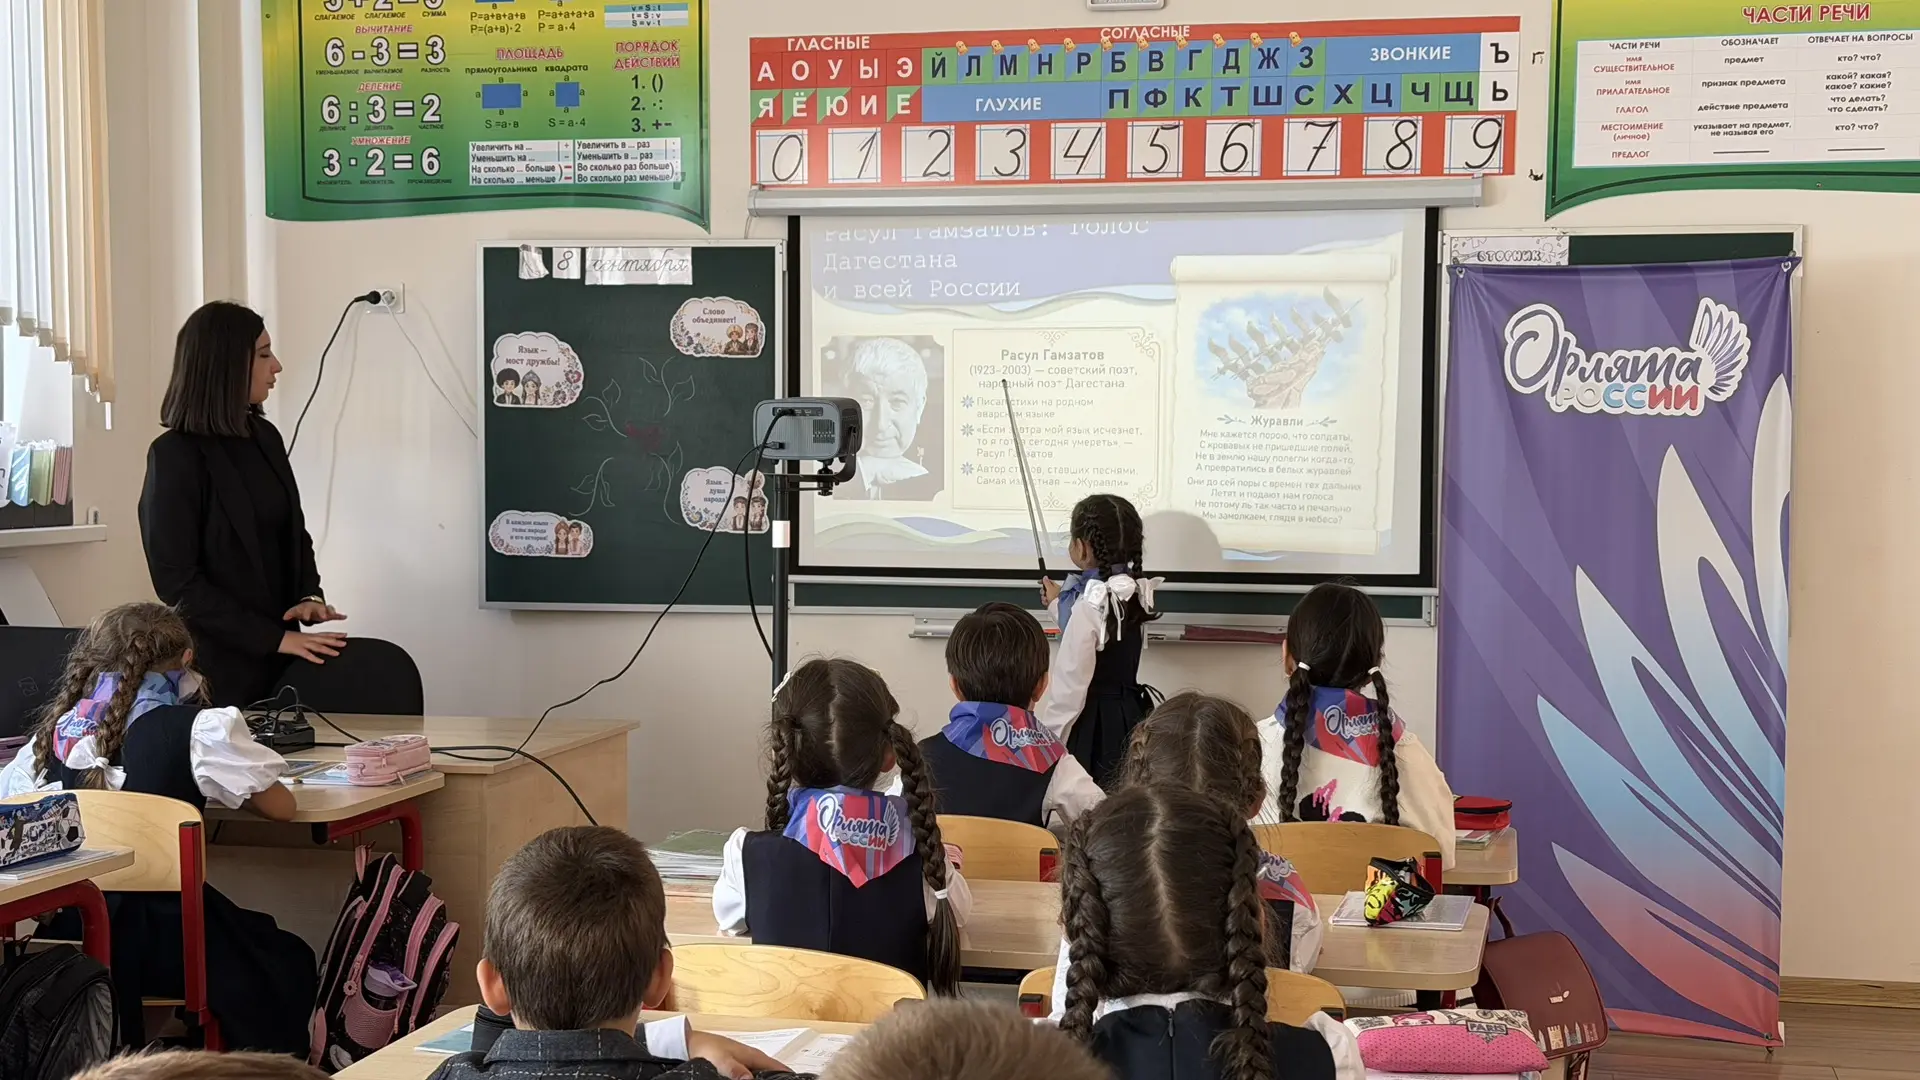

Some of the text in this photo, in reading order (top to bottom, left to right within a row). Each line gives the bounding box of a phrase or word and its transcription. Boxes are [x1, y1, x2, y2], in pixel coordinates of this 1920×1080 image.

[364, 12, 407, 20] СЛАГАЕМОЕ
[1743, 3, 1872, 25] ЧАСТИ РЕЧИ
[355, 25, 413, 34] ВЫЧИТАНИЕ
[1100, 25, 1190, 40] СОГЛАСНЫЕ
[1721, 37, 1779, 47] ОБОЗНАЧАЕТ
[1807, 33, 1913, 44] ОТВЕЧАЕТ НА ВОПРОСЫ
[615, 40, 679, 52] ПОРЯДОК
[787, 37, 871, 52] ГЛАСНЫЕ
[1609, 41, 1661, 50] ЧАСТИ РЕЧИ
[325, 34, 447, 68] 6 3 3
[496, 48, 565, 60] ПЛОЩАДЬ
[1369, 46, 1452, 62] ЗВОНКИЕ
[1489, 42, 1510, 64] Ъ
[614, 56, 680, 70] ДЕЙСТВИЙ
[1724, 56, 1764, 65] предмет
[1837, 53, 1882, 63] кто? что?
[545, 64, 589, 74] квадрата
[757, 46, 1315, 82] А О У Ы Э Й Л М Н Р Б В Г Д Ж З
[1593, 64, 1675, 73] СУЩЕСТВИТЕЛЬНОЕ
[465, 65, 538, 75] прямоугольника
[1826, 71, 1892, 81] какой? какая?
[359, 82, 402, 91] ДЕЛЕНИЕ
[1702, 78, 1786, 88] признак предмета
[1825, 81, 1892, 91] какое? какие?
[1109, 81, 1474, 109] П Ф К Т Ш С Х Ц Ч Щ
[1491, 80, 1509, 102] Ь
[1596, 87, 1671, 96] ПРИЛАГАТЕЛЬНОЕ
[758, 91, 912, 118] Я Ё Ю И Е
[975, 97, 1042, 112] ГЛУХИЕ
[1830, 94, 1887, 104] что делать?
[321, 92, 442, 125] 6 3 2
[1616, 106, 1649, 114] ГЛАГОЛ
[1697, 102, 1789, 112] действие предмета
[1827, 104, 1889, 114] что сделать?
[1600, 122, 1664, 131] МЕСТОИМЕНИЕ
[1693, 123, 1737, 132] указывает
[1752, 121, 1792, 130] предмет,
[1835, 122, 1880, 132] кто? что?
[351, 136, 411, 146] УМНОЖЕНИЕ
[1613, 132, 1651, 142] (личное)
[471, 142, 524, 152] Увеличить на
[577, 141, 619, 150] Увеличить
[637, 141, 651, 151] раз
[772, 117, 1503, 182] 0 1 2 3 4 5 6 7 8 9
[471, 153, 527, 162] Уменьшить на
[577, 152, 622, 161] Уменьшить
[639, 152, 653, 161] раз
[1612, 150, 1651, 159] ПРЕДЛОГ
[322, 146, 441, 178] 3 2 6
[577, 163, 588, 172] Во
[623, 164, 637, 173] раз
[638, 161, 670, 170] больше
[471, 163, 556, 173] На сколько больше
[557, 250, 574, 271] 8
[1477, 250, 1542, 263] ВТОРНИК
[823, 252, 958, 274] Дагестана
[824, 278, 1021, 300] и всей России
[1001, 349, 1105, 363] Расул Гамзатов
[1510, 309, 1702, 398] Орлята
[1047, 363, 1106, 375] советский
[1556, 383, 1699, 411] РОССИИ
[1250, 415, 1304, 429] Журавли
